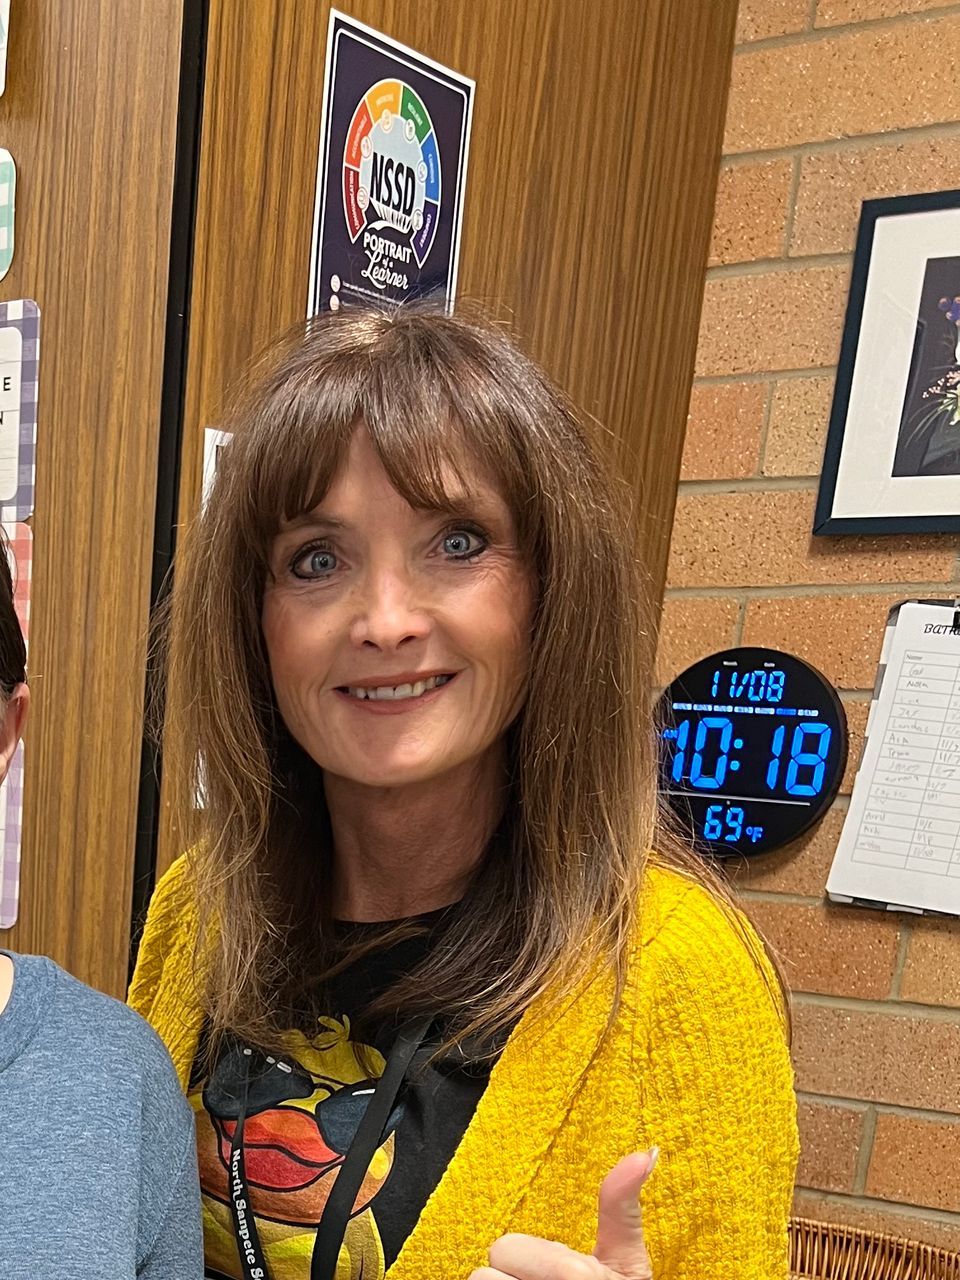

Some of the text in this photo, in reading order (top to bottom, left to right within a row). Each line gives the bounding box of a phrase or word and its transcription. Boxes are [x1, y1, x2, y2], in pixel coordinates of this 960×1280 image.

[370, 151, 416, 217] NSSD
[360, 249, 409, 290] Learner
[363, 231, 412, 264] PORTRAIT
[711, 670, 786, 702] 11/08
[672, 717, 831, 796] 10:18
[704, 805, 764, 843] 69 °F
[232, 1149, 242, 1199] North
[236, 1199, 256, 1265] Sanpete
